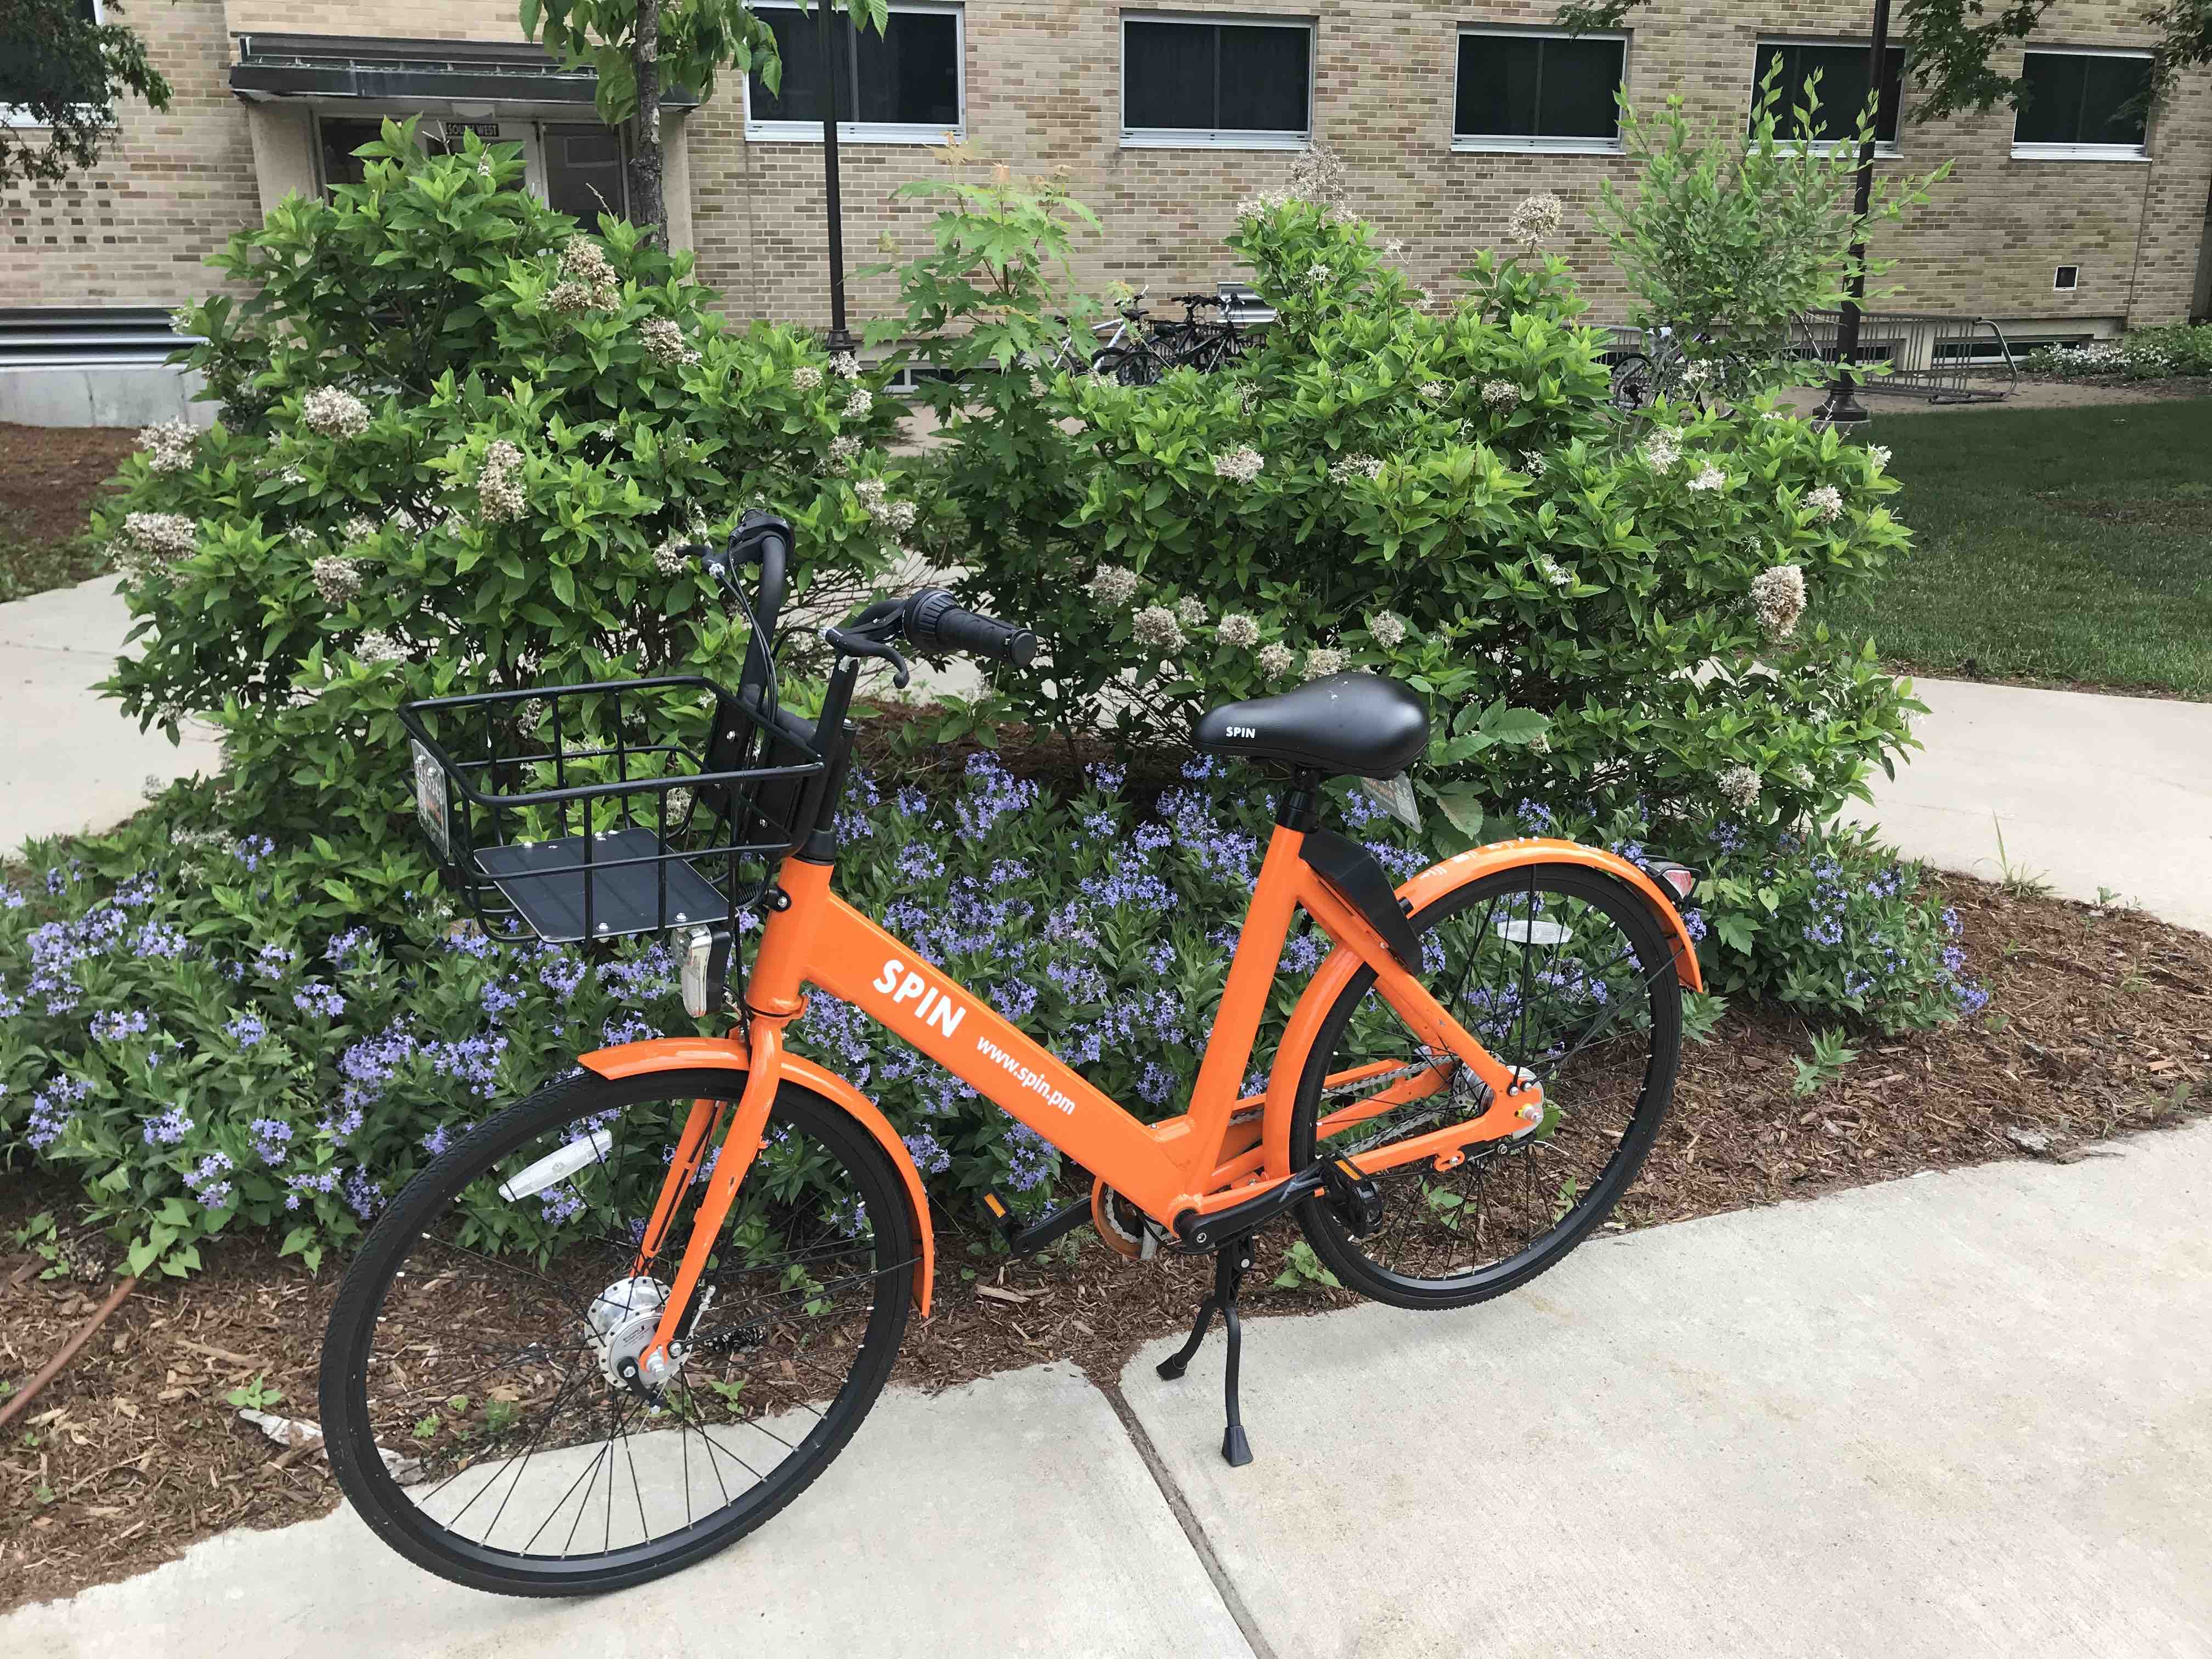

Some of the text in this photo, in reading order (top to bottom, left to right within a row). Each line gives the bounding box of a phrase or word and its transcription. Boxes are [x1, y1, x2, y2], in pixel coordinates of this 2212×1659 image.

[448, 124, 498, 136] SOU WEST
[1226, 726, 1255, 738] SPIN
[873, 960, 966, 1038] SPIN
[976, 1036, 1076, 1115] www.spin.pm
